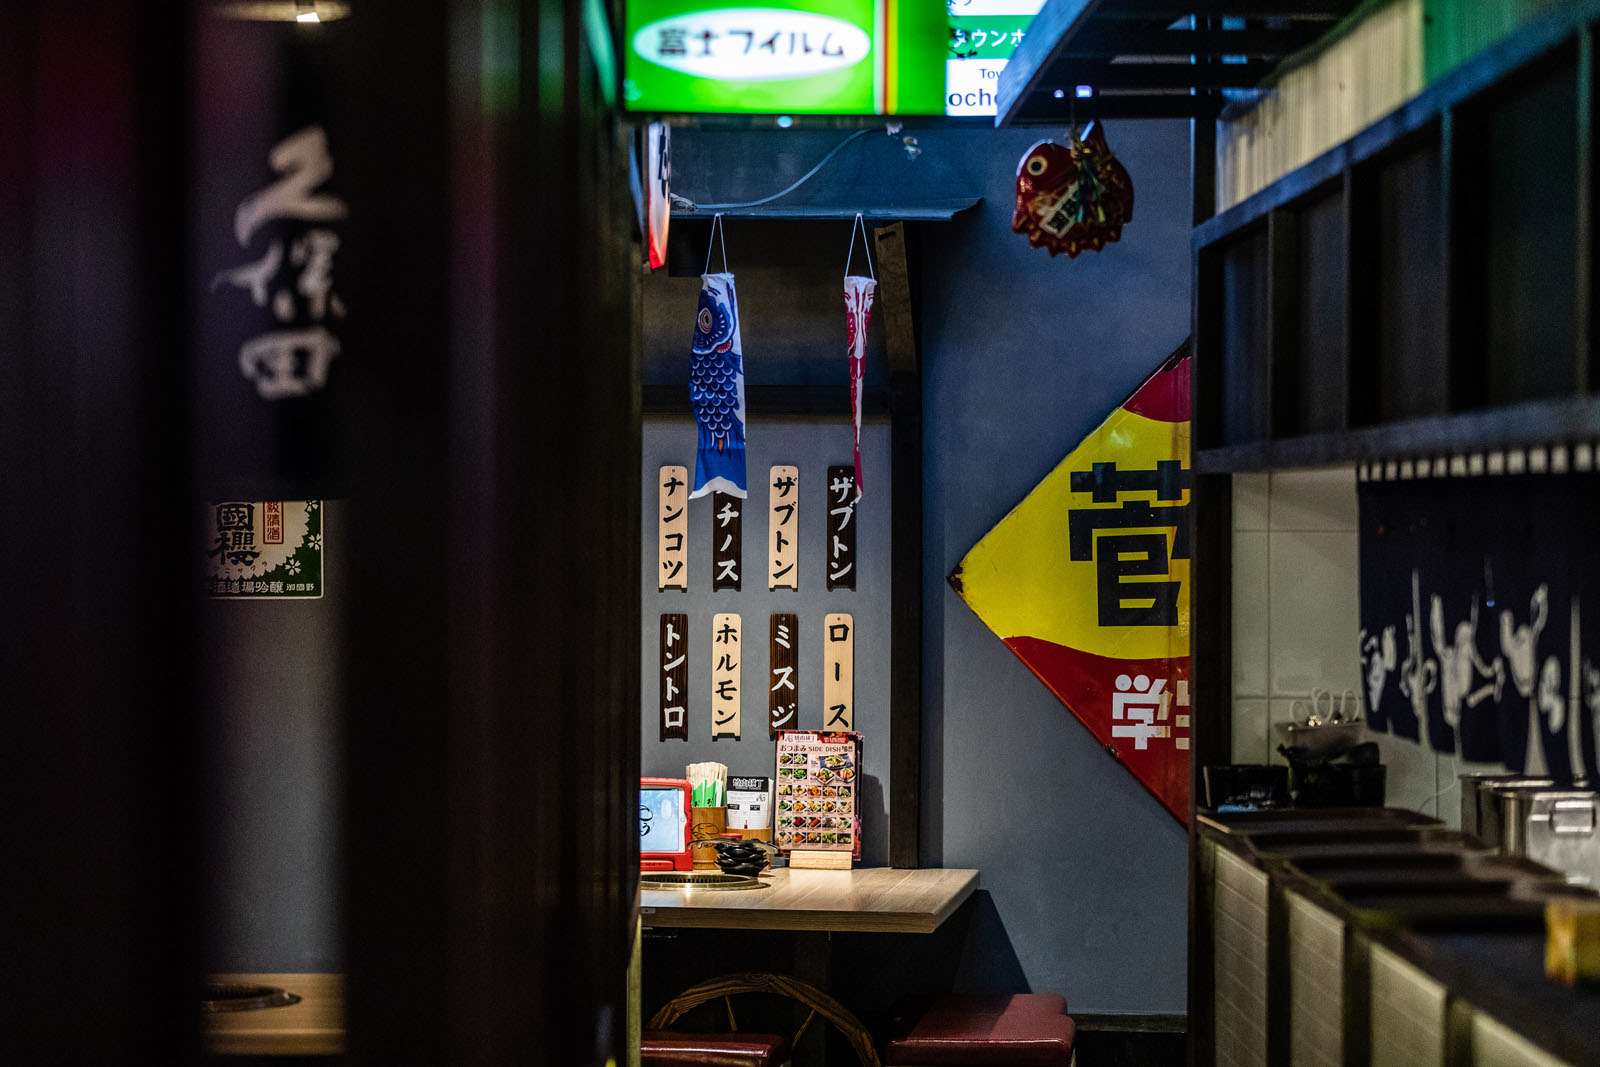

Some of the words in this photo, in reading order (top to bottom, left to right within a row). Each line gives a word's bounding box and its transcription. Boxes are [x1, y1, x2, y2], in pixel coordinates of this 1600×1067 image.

[657, 26, 846, 58] 富士フイルム
[948, 88, 998, 107] och
[662, 476, 684, 580] ナンコツ
[716, 491, 740, 582] チノス
[772, 475, 798, 580] ザブトン
[829, 476, 855, 582] ザブトン
[662, 623, 686, 730] トントロ
[714, 623, 739, 727] ホルモン
[770, 624, 797, 729] ミスジ
[826, 623, 850, 727] ロース
